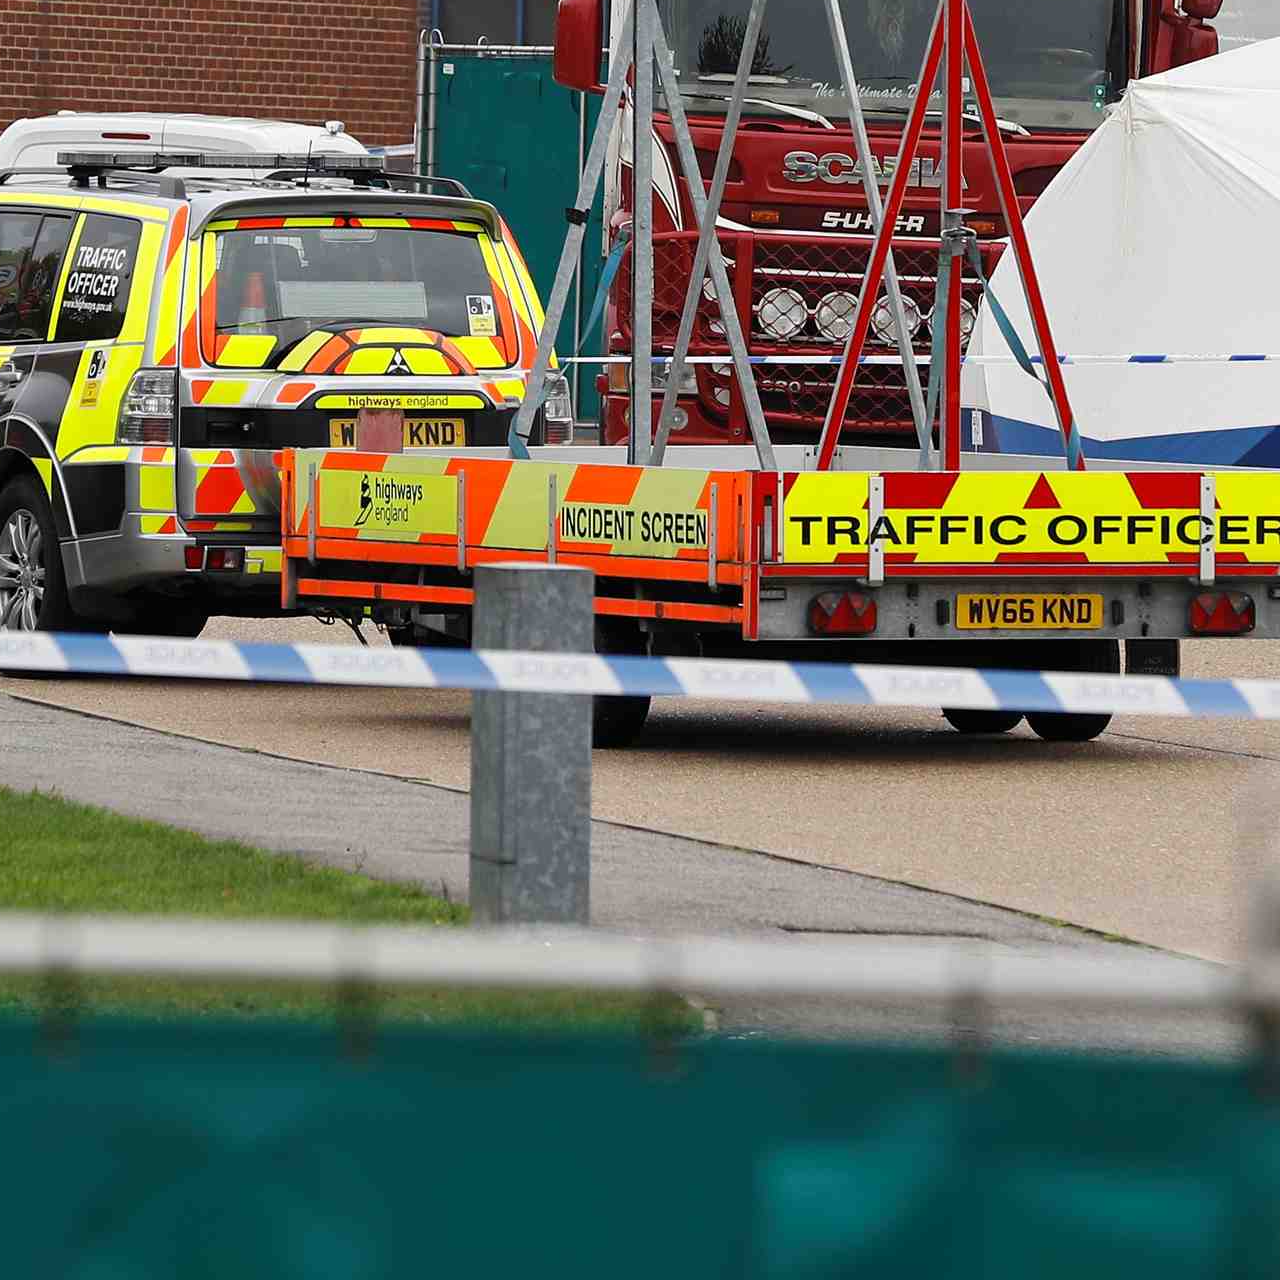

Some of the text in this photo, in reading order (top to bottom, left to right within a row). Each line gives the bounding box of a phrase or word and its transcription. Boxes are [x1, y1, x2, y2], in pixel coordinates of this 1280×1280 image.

[822, 211, 925, 232] SUR
[77, 246, 127, 270] TRAFFIC
[68, 271, 120, 297] OFFICER
[348, 396, 449, 408] highways england
[409, 422, 456, 446] KND
[375, 477, 423, 505] highways
[375, 503, 409, 526] england
[561, 506, 707, 545] INCIDENT SCREEN
[789, 515, 1027, 545] TRAFFIC
[968, 597, 1093, 624] WV66 KND
